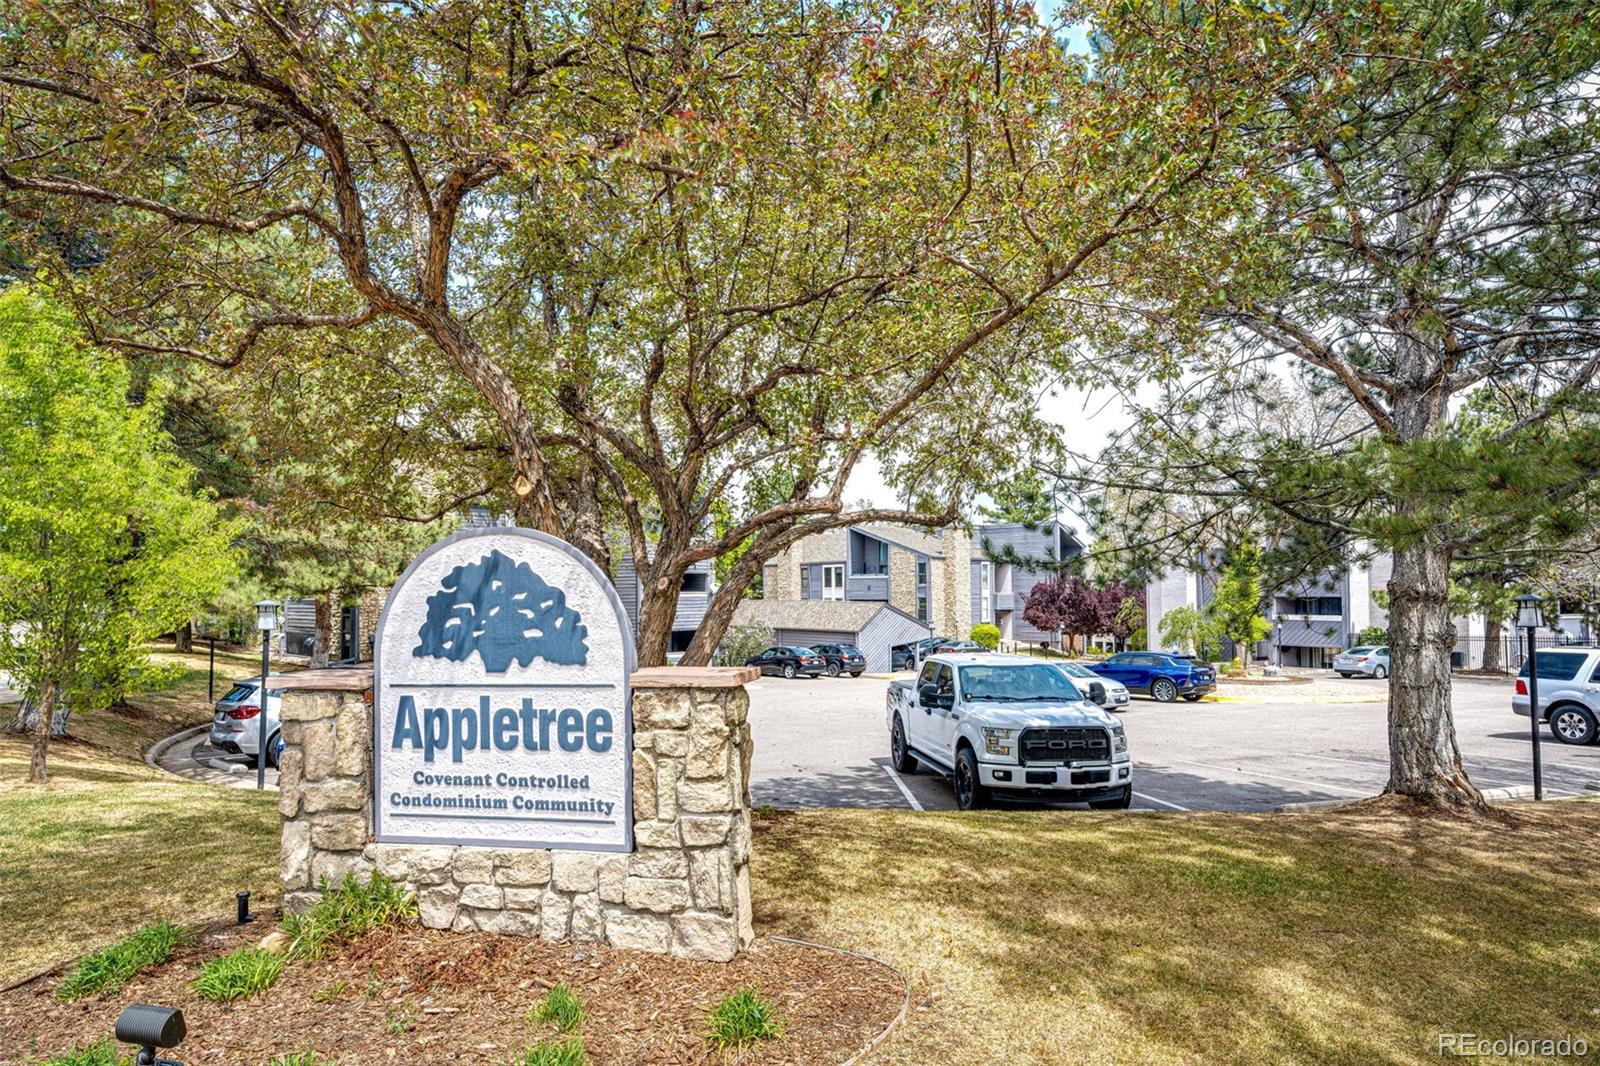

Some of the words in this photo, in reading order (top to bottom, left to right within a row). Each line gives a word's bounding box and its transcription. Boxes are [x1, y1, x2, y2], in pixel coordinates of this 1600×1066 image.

[392, 695, 613, 763] Appletree
[1024, 740, 1107, 749] FORD
[413, 771, 492, 787] Covenant
[496, 772, 590, 789] Controlled
[390, 792, 508, 810] Condominium
[512, 795, 615, 816] Community
